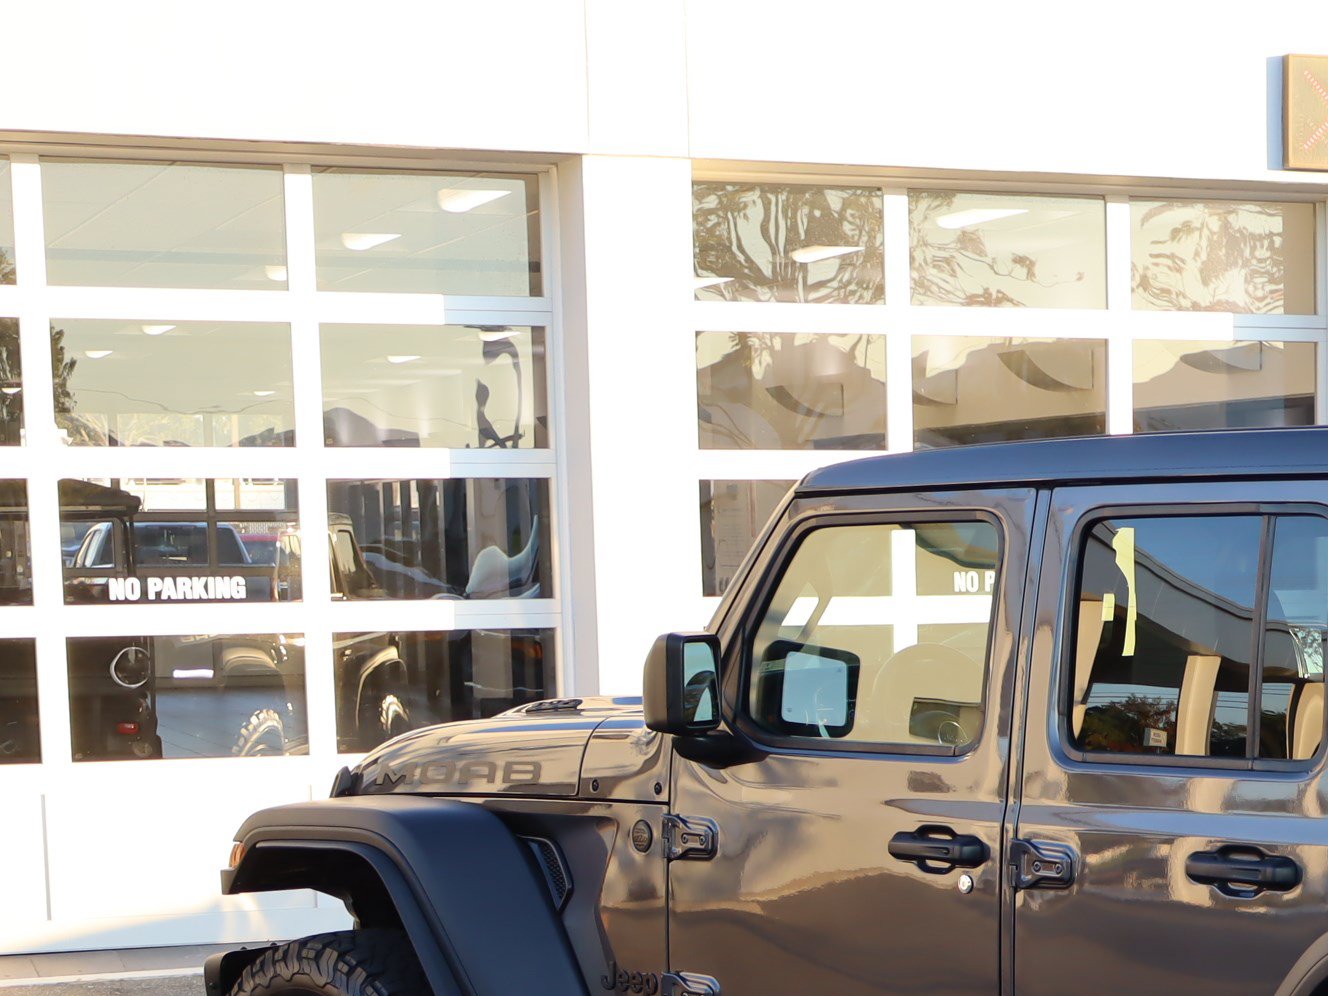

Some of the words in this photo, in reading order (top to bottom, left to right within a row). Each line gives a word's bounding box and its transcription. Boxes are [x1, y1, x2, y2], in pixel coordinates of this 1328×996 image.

[108, 577, 141, 600] NO
[147, 576, 246, 600] PARKING
[953, 571, 979, 592] NO
[375, 761, 542, 786] MOAB
